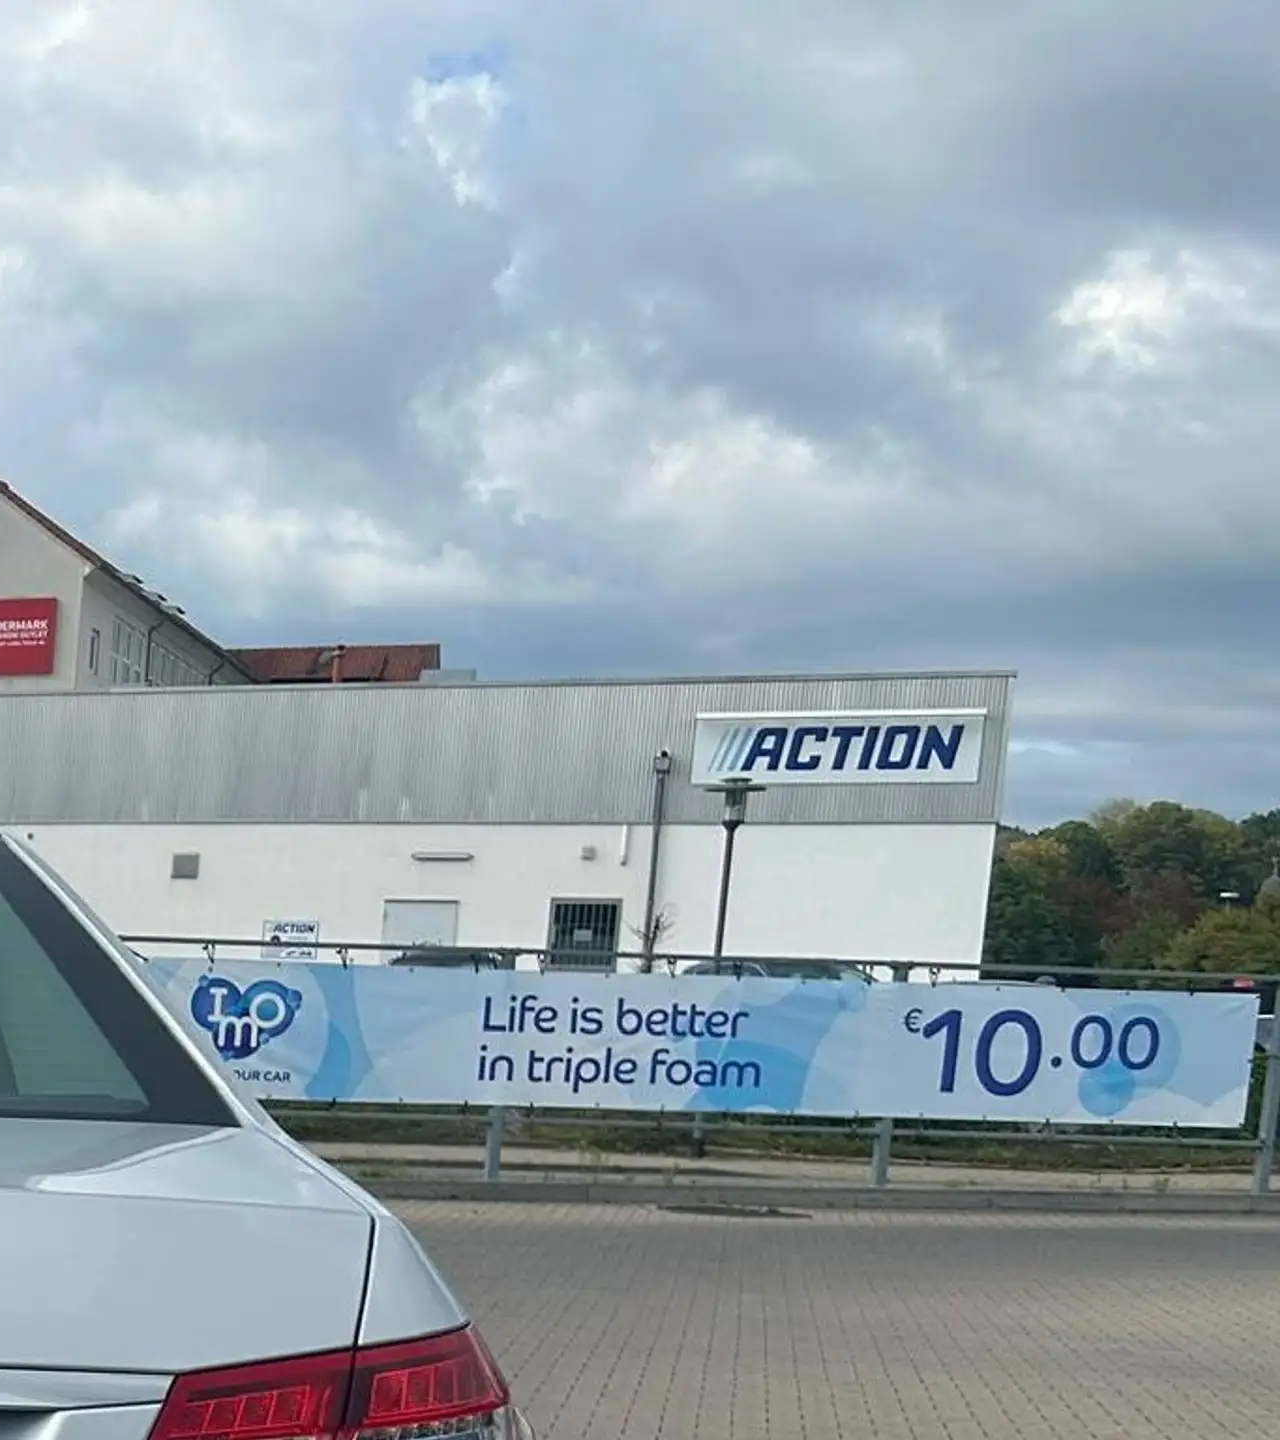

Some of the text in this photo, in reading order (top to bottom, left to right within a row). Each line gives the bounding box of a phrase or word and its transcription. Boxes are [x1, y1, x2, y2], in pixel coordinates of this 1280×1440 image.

[740, 723, 966, 772] ACTION
[273, 923, 316, 934] ACTION
[482, 995, 750, 1039] Life is better
[263, 1070, 291, 1082] CAR
[478, 1045, 761, 1093] in triple foam
